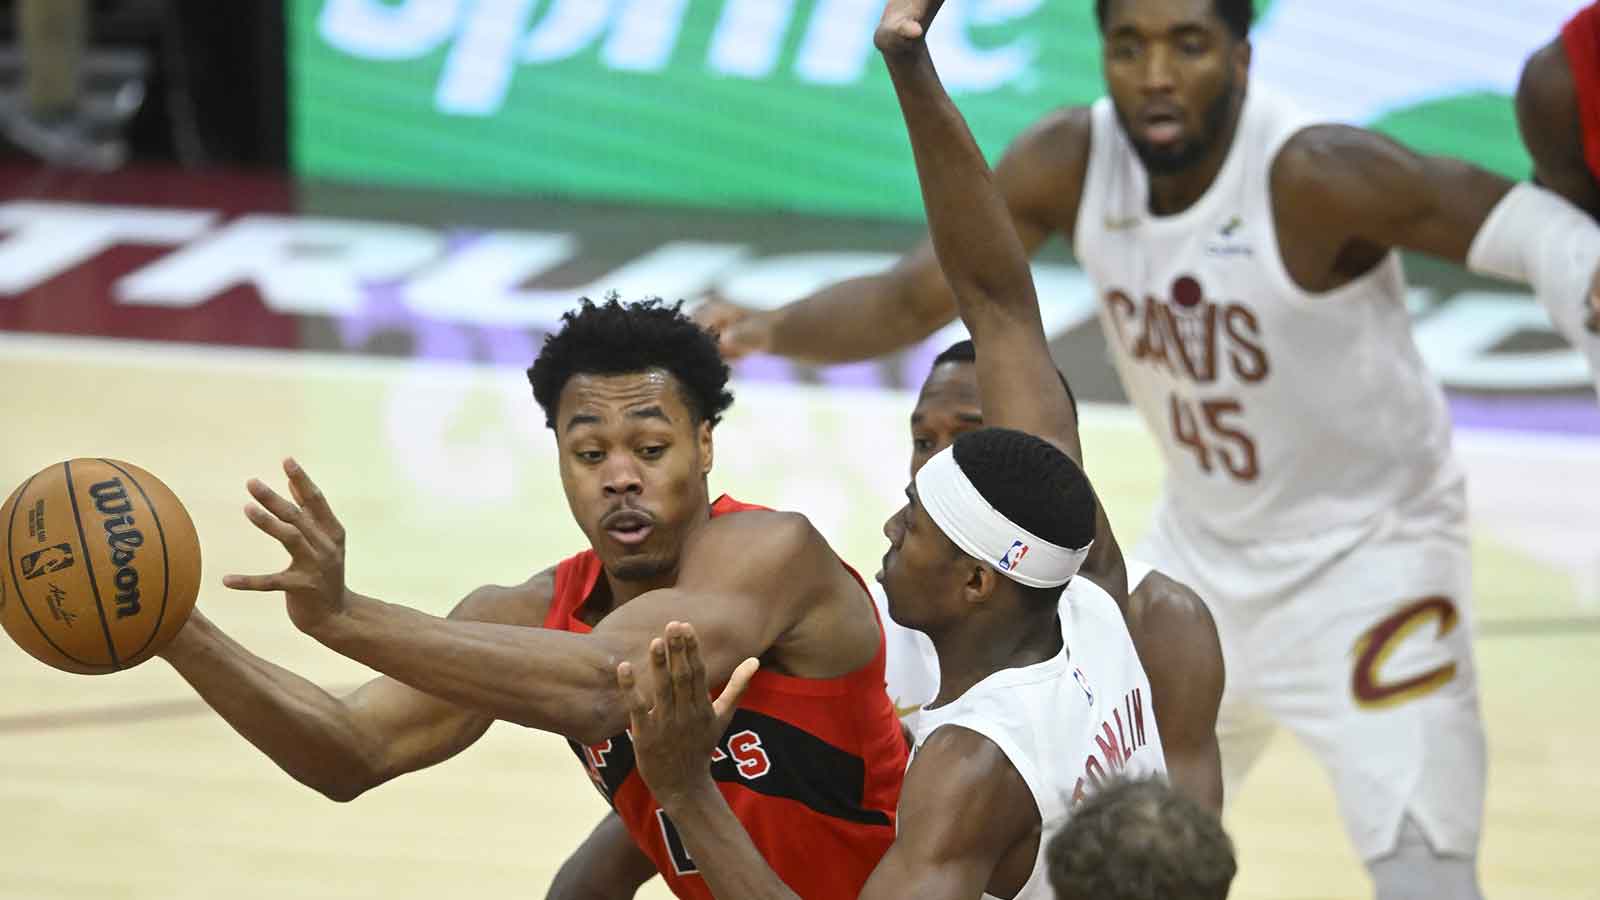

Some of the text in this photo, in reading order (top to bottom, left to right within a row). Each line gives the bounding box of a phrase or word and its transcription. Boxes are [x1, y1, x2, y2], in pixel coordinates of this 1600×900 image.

[1105, 288, 1271, 385] CAVS
[1169, 392, 1260, 483] 45
[89, 477, 145, 621] Wilson
